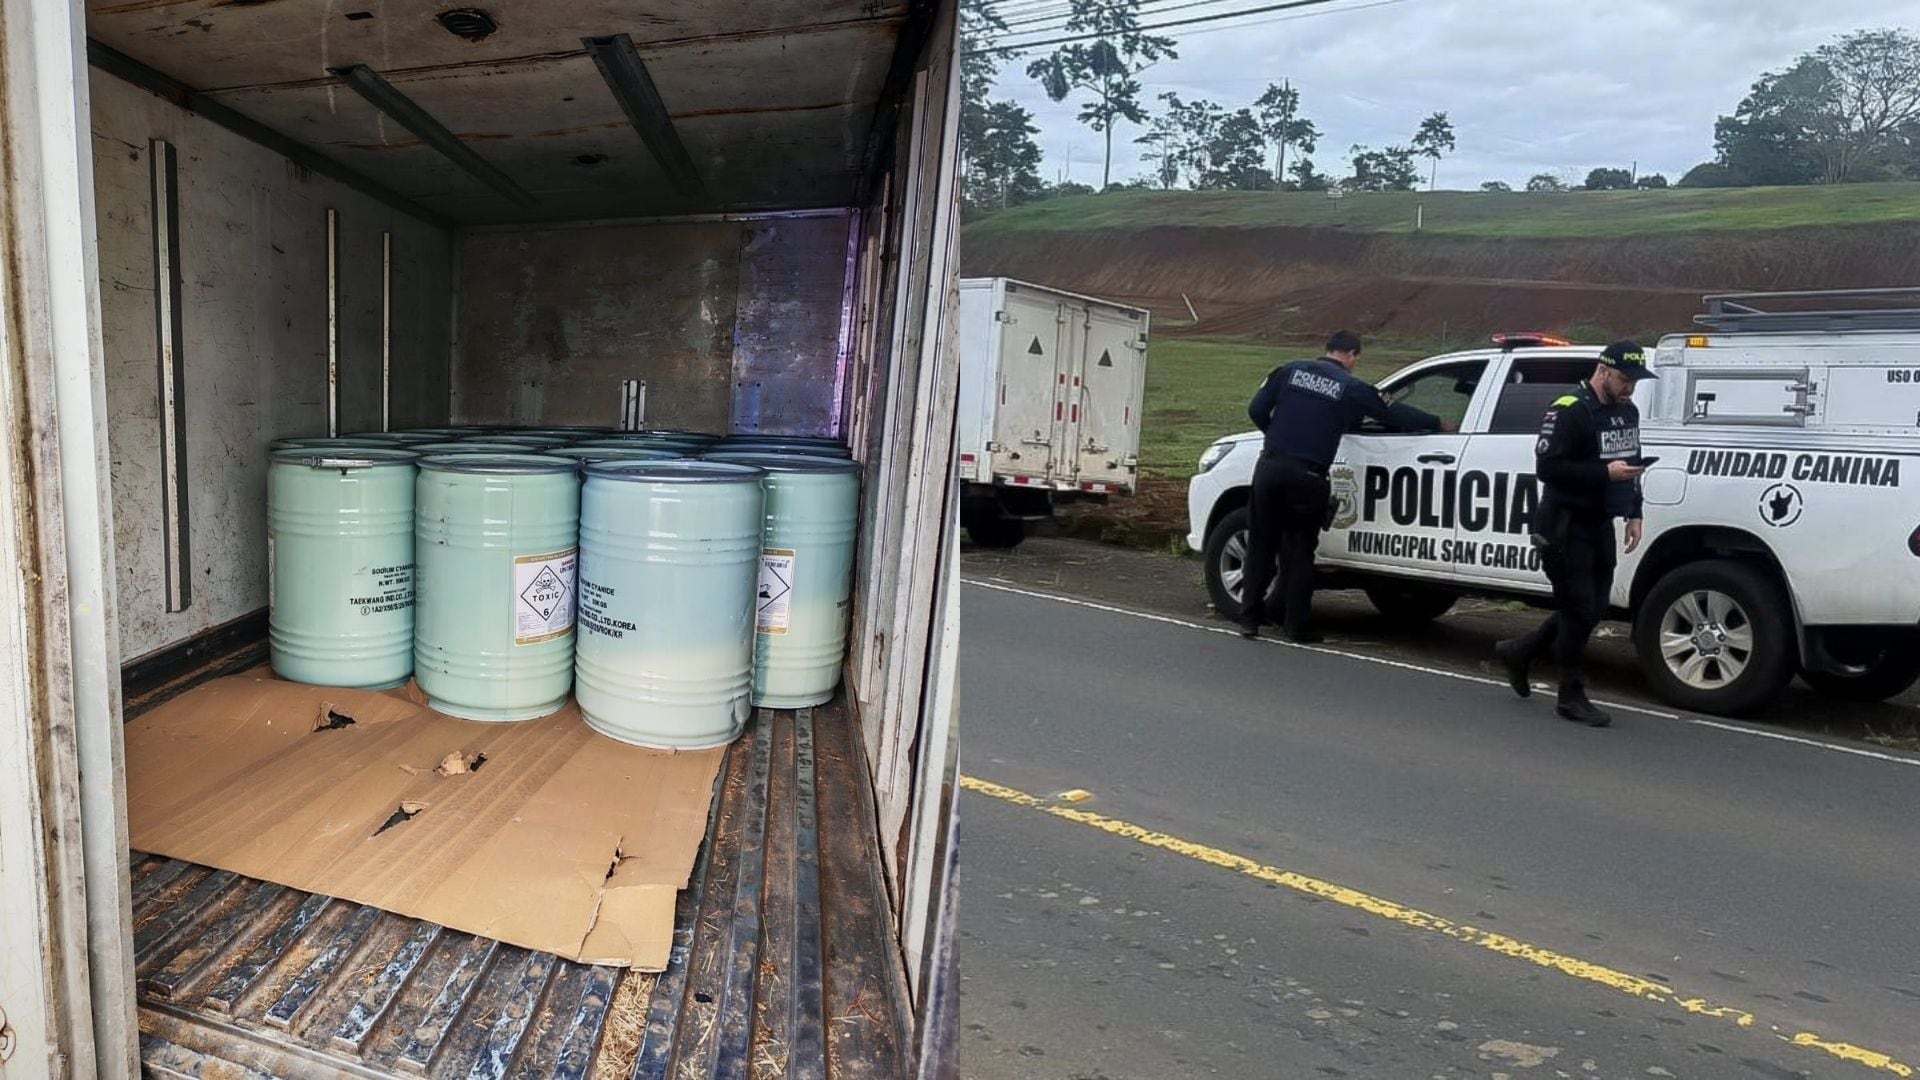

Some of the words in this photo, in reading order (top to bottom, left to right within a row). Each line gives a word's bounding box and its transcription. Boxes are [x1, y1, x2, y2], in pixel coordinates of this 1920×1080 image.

[1292, 369, 1341, 392] POLICIA
[1887, 369, 1911, 383] USO
[1291, 379, 1338, 399] MUNICIPAL
[1687, 450, 1787, 479] UNIDAD
[1791, 454, 1900, 487] CANINA
[1363, 465, 1541, 535] POLICIA
[1347, 531, 1437, 561] MUNICIPAL
[1441, 539, 1478, 565] SAN
[1480, 542, 1543, 572] CARLO
[371, 566, 395, 575] SODIUM
[591, 583, 615, 596] CYANIDE
[350, 596, 385, 605] TAEKWANG
[532, 592, 560, 602] TOXIC
[543, 608, 549, 617] 6
